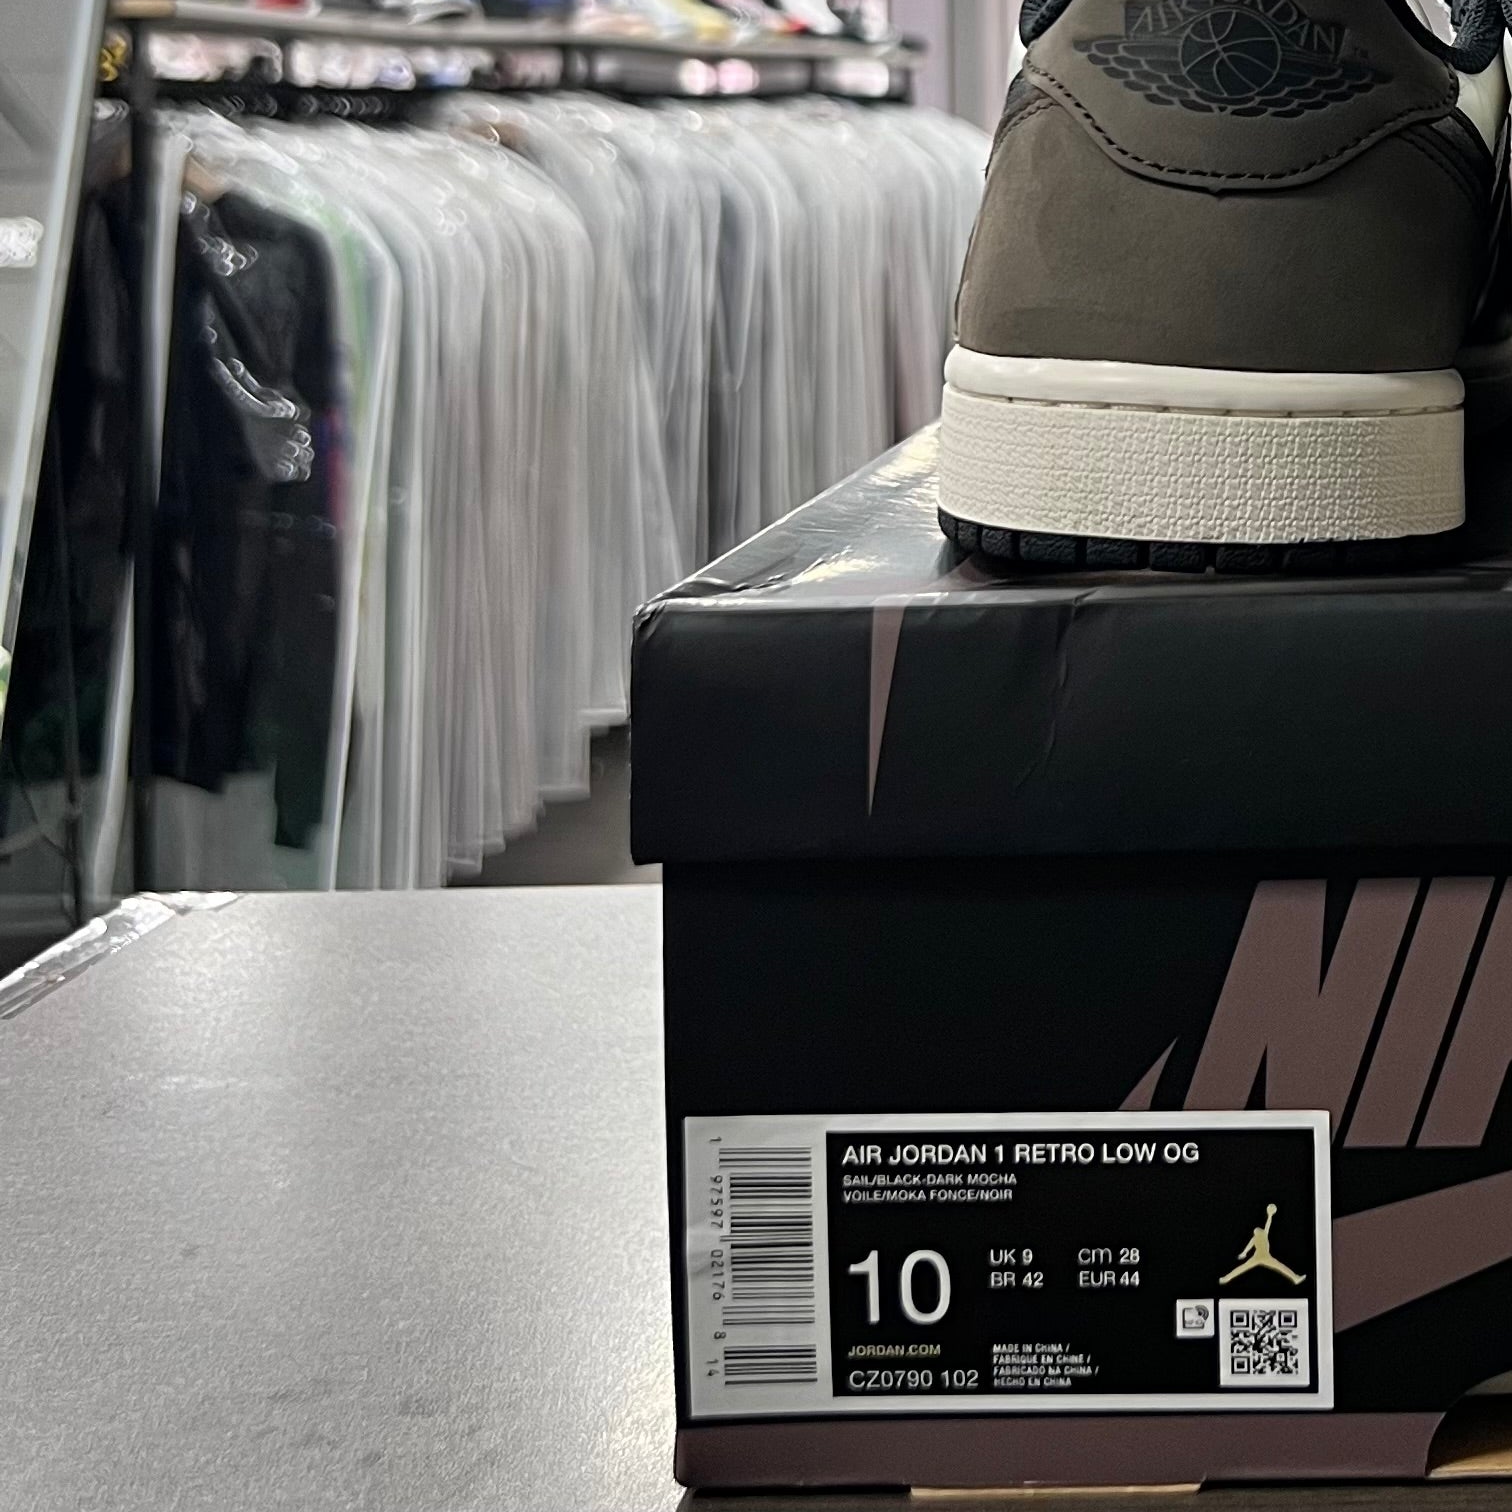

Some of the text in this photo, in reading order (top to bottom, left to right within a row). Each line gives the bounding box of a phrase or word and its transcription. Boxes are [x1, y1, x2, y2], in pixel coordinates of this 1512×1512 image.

[842, 1143, 1199, 1165] AIR JORDAN 1 RETRO LOW OG
[968, 1173, 1017, 1185] MOCHA
[710, 1174, 724, 1230] 97597
[844, 1190, 926, 1202] VOILE/MOKA
[990, 1249, 1032, 1265] UK 9
[1120, 1248, 1140, 1264] 28
[710, 1248, 726, 1302] 02176
[991, 1272, 1043, 1288] BR 42
[1080, 1271, 1139, 1287] EUR 44
[849, 1250, 951, 1324] 10
[848, 1344, 940, 1356] JORDAN.COM
[993, 1344, 1019, 1353] MADE
[1022, 1344, 1032, 1353] IN
[1035, 1343, 1063, 1353] CHINA
[993, 1354, 1038, 1364] FABRIQUE
[1041, 1354, 1053, 1363] EN
[850, 1370, 978, 1389] CZ0790 102
[1044, 1377, 1072, 1386] CHINA
